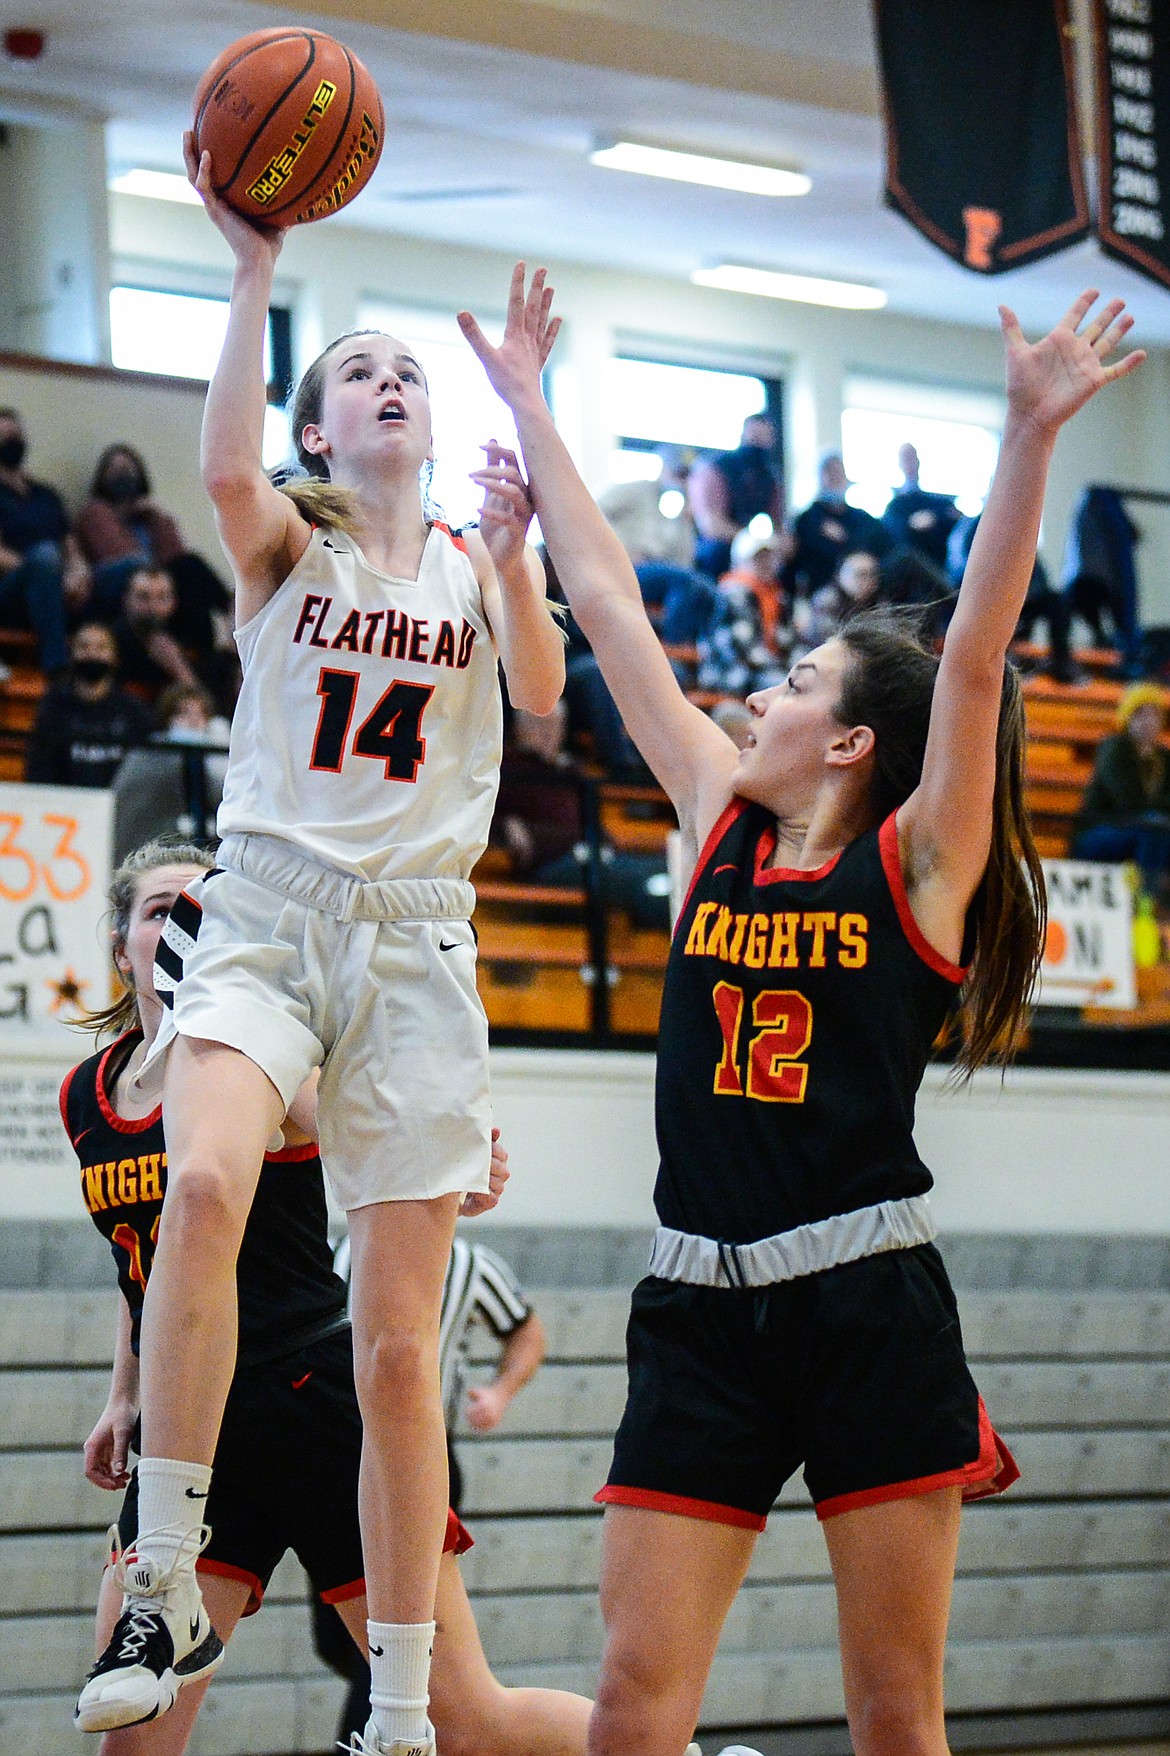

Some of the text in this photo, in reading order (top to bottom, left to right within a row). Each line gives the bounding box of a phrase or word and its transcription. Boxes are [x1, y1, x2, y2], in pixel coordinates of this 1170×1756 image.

[248, 80, 336, 205] ELITE PRO
[296, 110, 379, 222] Baden
[293, 593, 477, 669] FLATHEAD
[309, 667, 436, 783] 14
[684, 901, 869, 969] KNIGHTS
[713, 980, 813, 1103] 12
[80, 1152, 168, 1214] NIGH
[112, 1215, 162, 1293] 1
